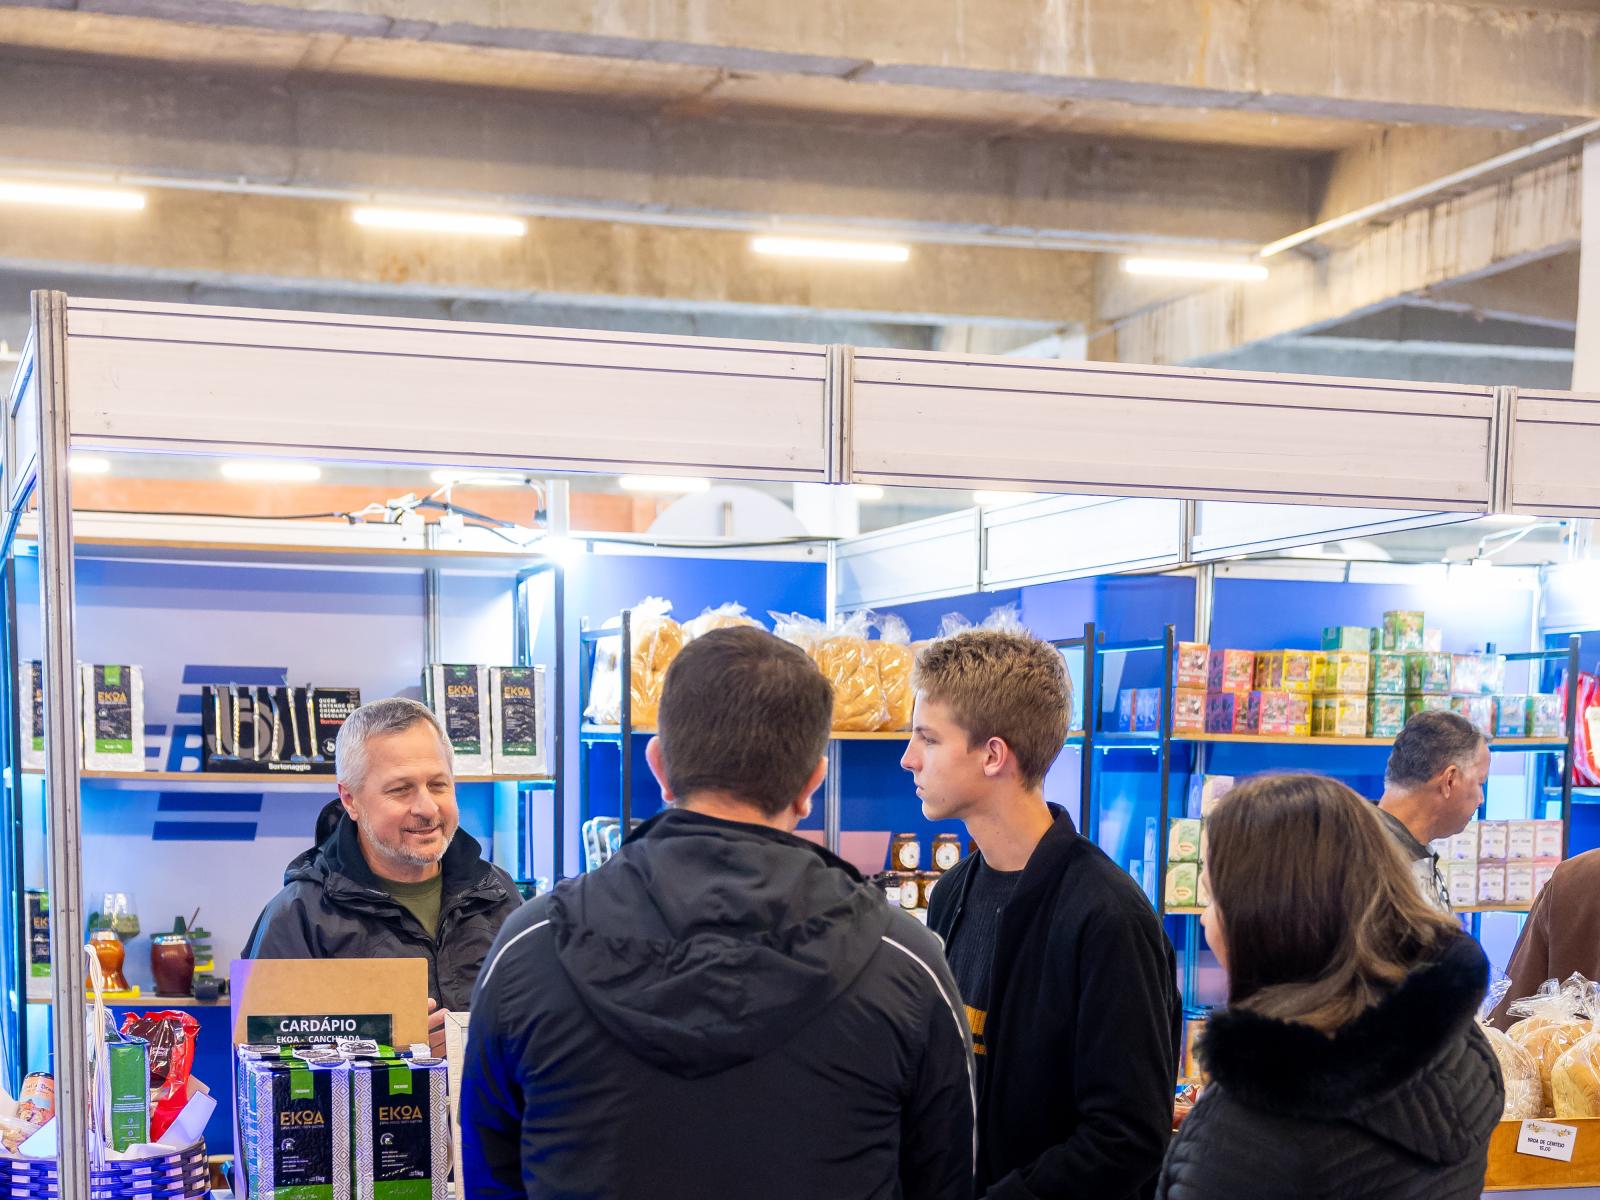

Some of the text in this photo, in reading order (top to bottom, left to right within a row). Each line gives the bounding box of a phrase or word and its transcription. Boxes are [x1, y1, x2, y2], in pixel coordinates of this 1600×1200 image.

[447, 685, 475, 696] EKOA
[503, 686, 531, 697] EKOA
[97, 691, 128, 703] EKOA
[268, 762, 311, 772] Bortonaggio
[279, 1016, 357, 1032] CARDÁPIO
[280, 1109, 325, 1126] EKOA
[379, 1105, 423, 1121] EKOA
